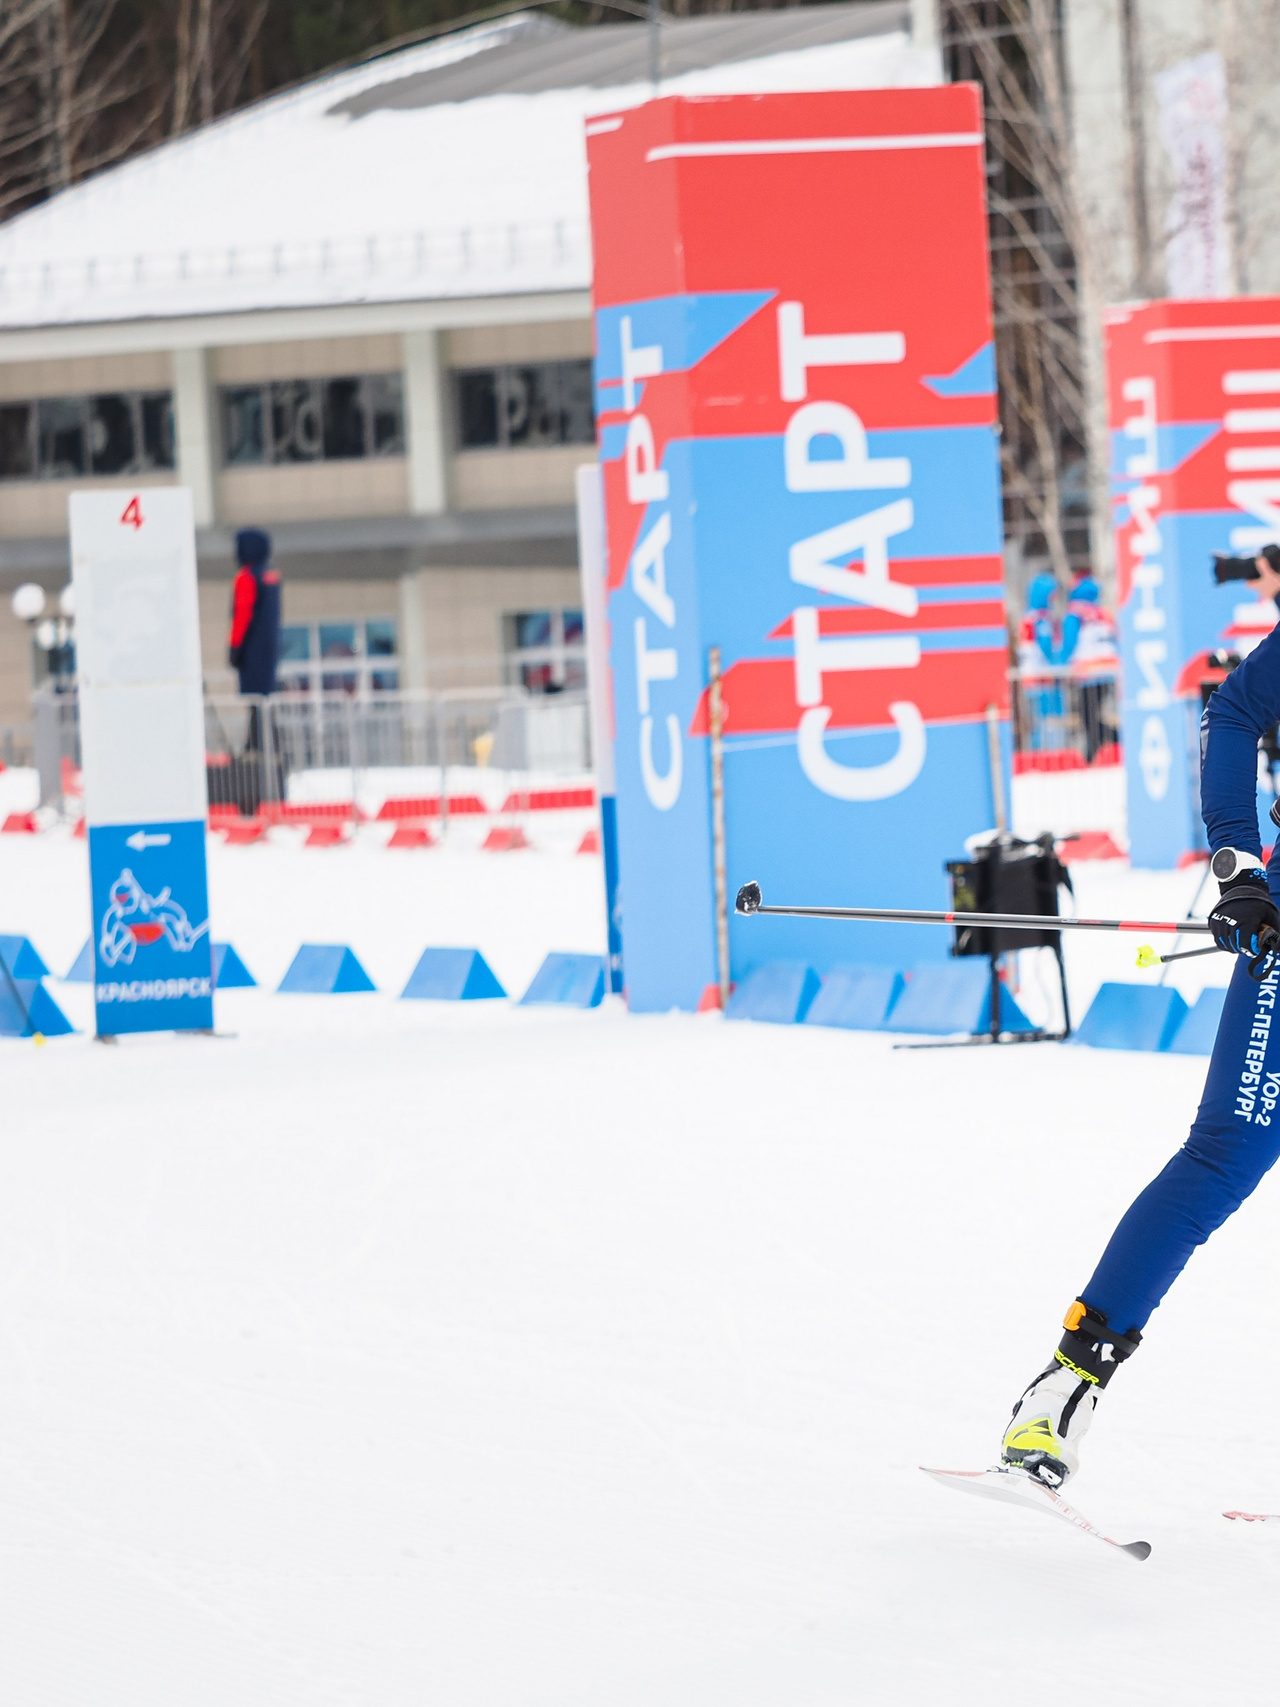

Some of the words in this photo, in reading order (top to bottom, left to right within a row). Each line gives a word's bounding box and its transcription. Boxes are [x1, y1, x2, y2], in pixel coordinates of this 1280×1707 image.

[119, 495, 146, 531] 4
[619, 315, 684, 812] СТАРТ
[777, 301, 928, 803] СТАРТ
[1122, 375, 1173, 800] ФИНИШ
[95, 977, 213, 1003] КРАСНОЯРСК
[1054, 1348, 1100, 1385] SCHER
